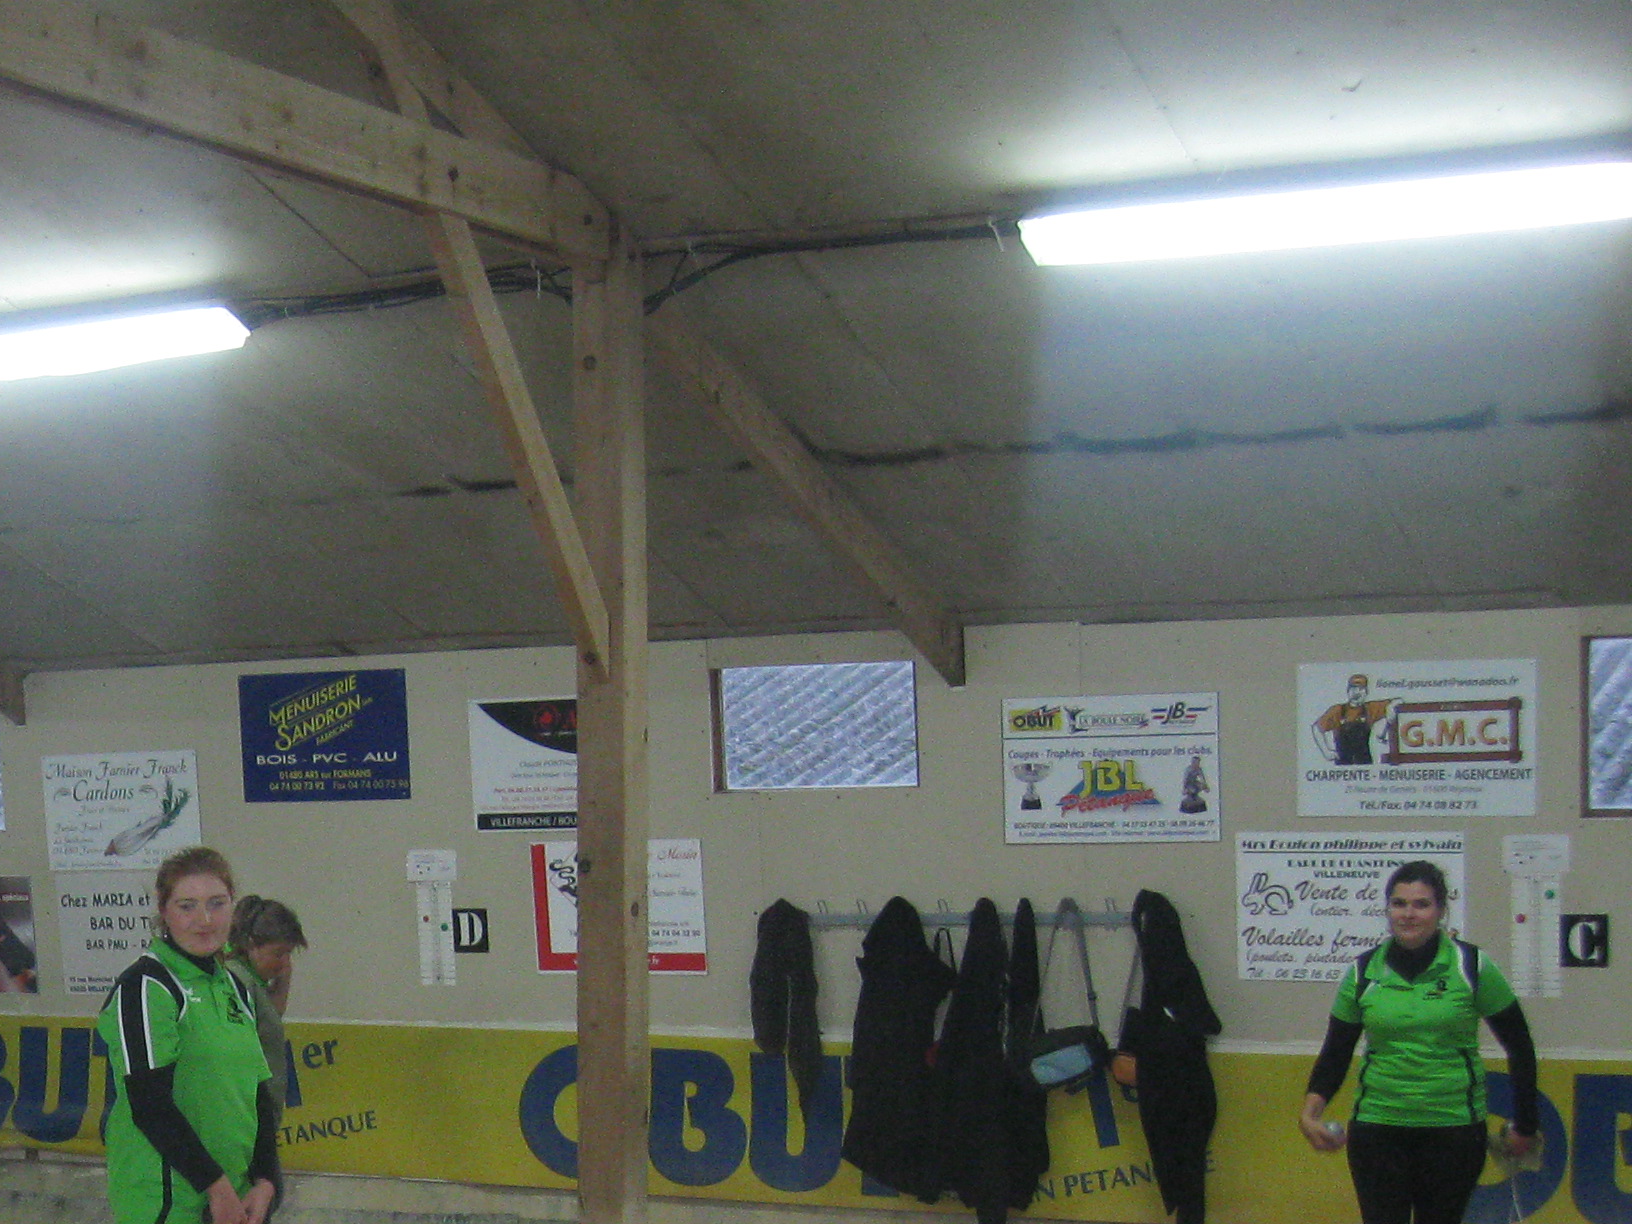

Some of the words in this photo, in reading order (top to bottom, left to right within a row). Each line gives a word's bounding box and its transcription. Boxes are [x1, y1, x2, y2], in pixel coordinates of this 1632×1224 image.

[269, 674, 357, 725] MENUISERIE
[275, 694, 361, 751] SANDRON
[1013, 713, 1055, 729] OBUT
[1400, 718, 1508, 748] G.M.C.
[257, 754, 298, 765] BOIS
[313, 753, 347, 764] PVC
[363, 751, 397, 763] ALU
[1078, 759, 1143, 798] JBL
[1306, 769, 1371, 782] CHARPENTE
[1379, 769, 1446, 781] MENUISERIE
[1454, 768, 1532, 780] AGENCEMENT
[72, 779, 135, 801] Cardons
[1313, 870, 1380, 879] VILLENEUVE
[61, 894, 87, 907] Chez
[93, 893, 133, 906] MARIA
[138, 894, 150, 906] et
[1294, 880, 1349, 901] Vente
[1355, 883, 1378, 901] de
[90, 917, 114, 930] BAR
[118, 917, 135, 930] DU
[457, 912, 483, 946] D
[86, 940, 105, 950] BAR
[108, 940, 128, 950] PMU
[1241, 925, 1324, 947] Volailles
[1568, 921, 1601, 961] C
